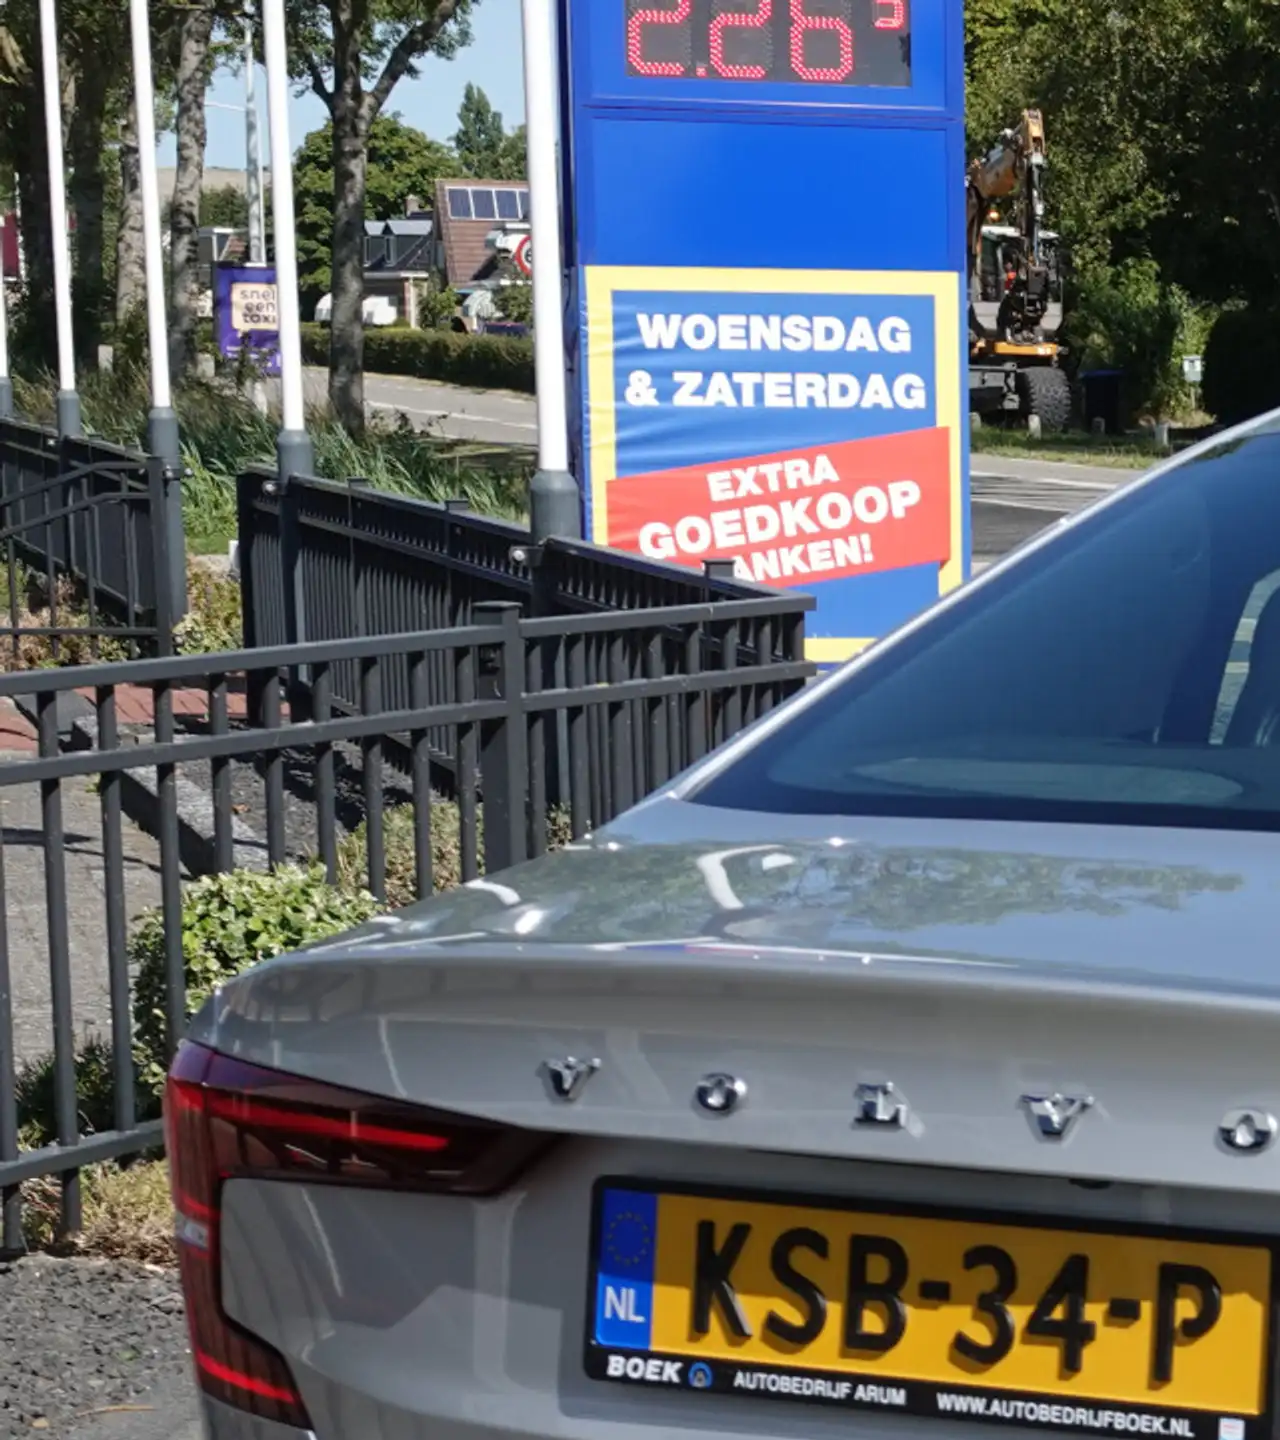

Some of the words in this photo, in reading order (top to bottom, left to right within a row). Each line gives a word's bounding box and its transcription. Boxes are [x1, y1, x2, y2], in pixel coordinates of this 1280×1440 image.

[636, 313, 911, 353] WOENSDAG
[624, 369, 660, 407] &
[672, 371, 926, 409] ZATERDAG
[706, 454, 840, 502] EXTRA
[639, 480, 921, 560] GOEDKOOP
[703, 533, 874, 583] ANKEN!
[603, 1285, 646, 1325] NL
[697, 1219, 1222, 1385] KSB-34-P
[606, 1354, 683, 1384] BOEK
[733, 1371, 852, 1400] AUTOBEDRIJF
[853, 1386, 907, 1406] ARUM
[936, 1392, 1196, 1439] WWW.AUTOBEDRIJFBOEK.NL
